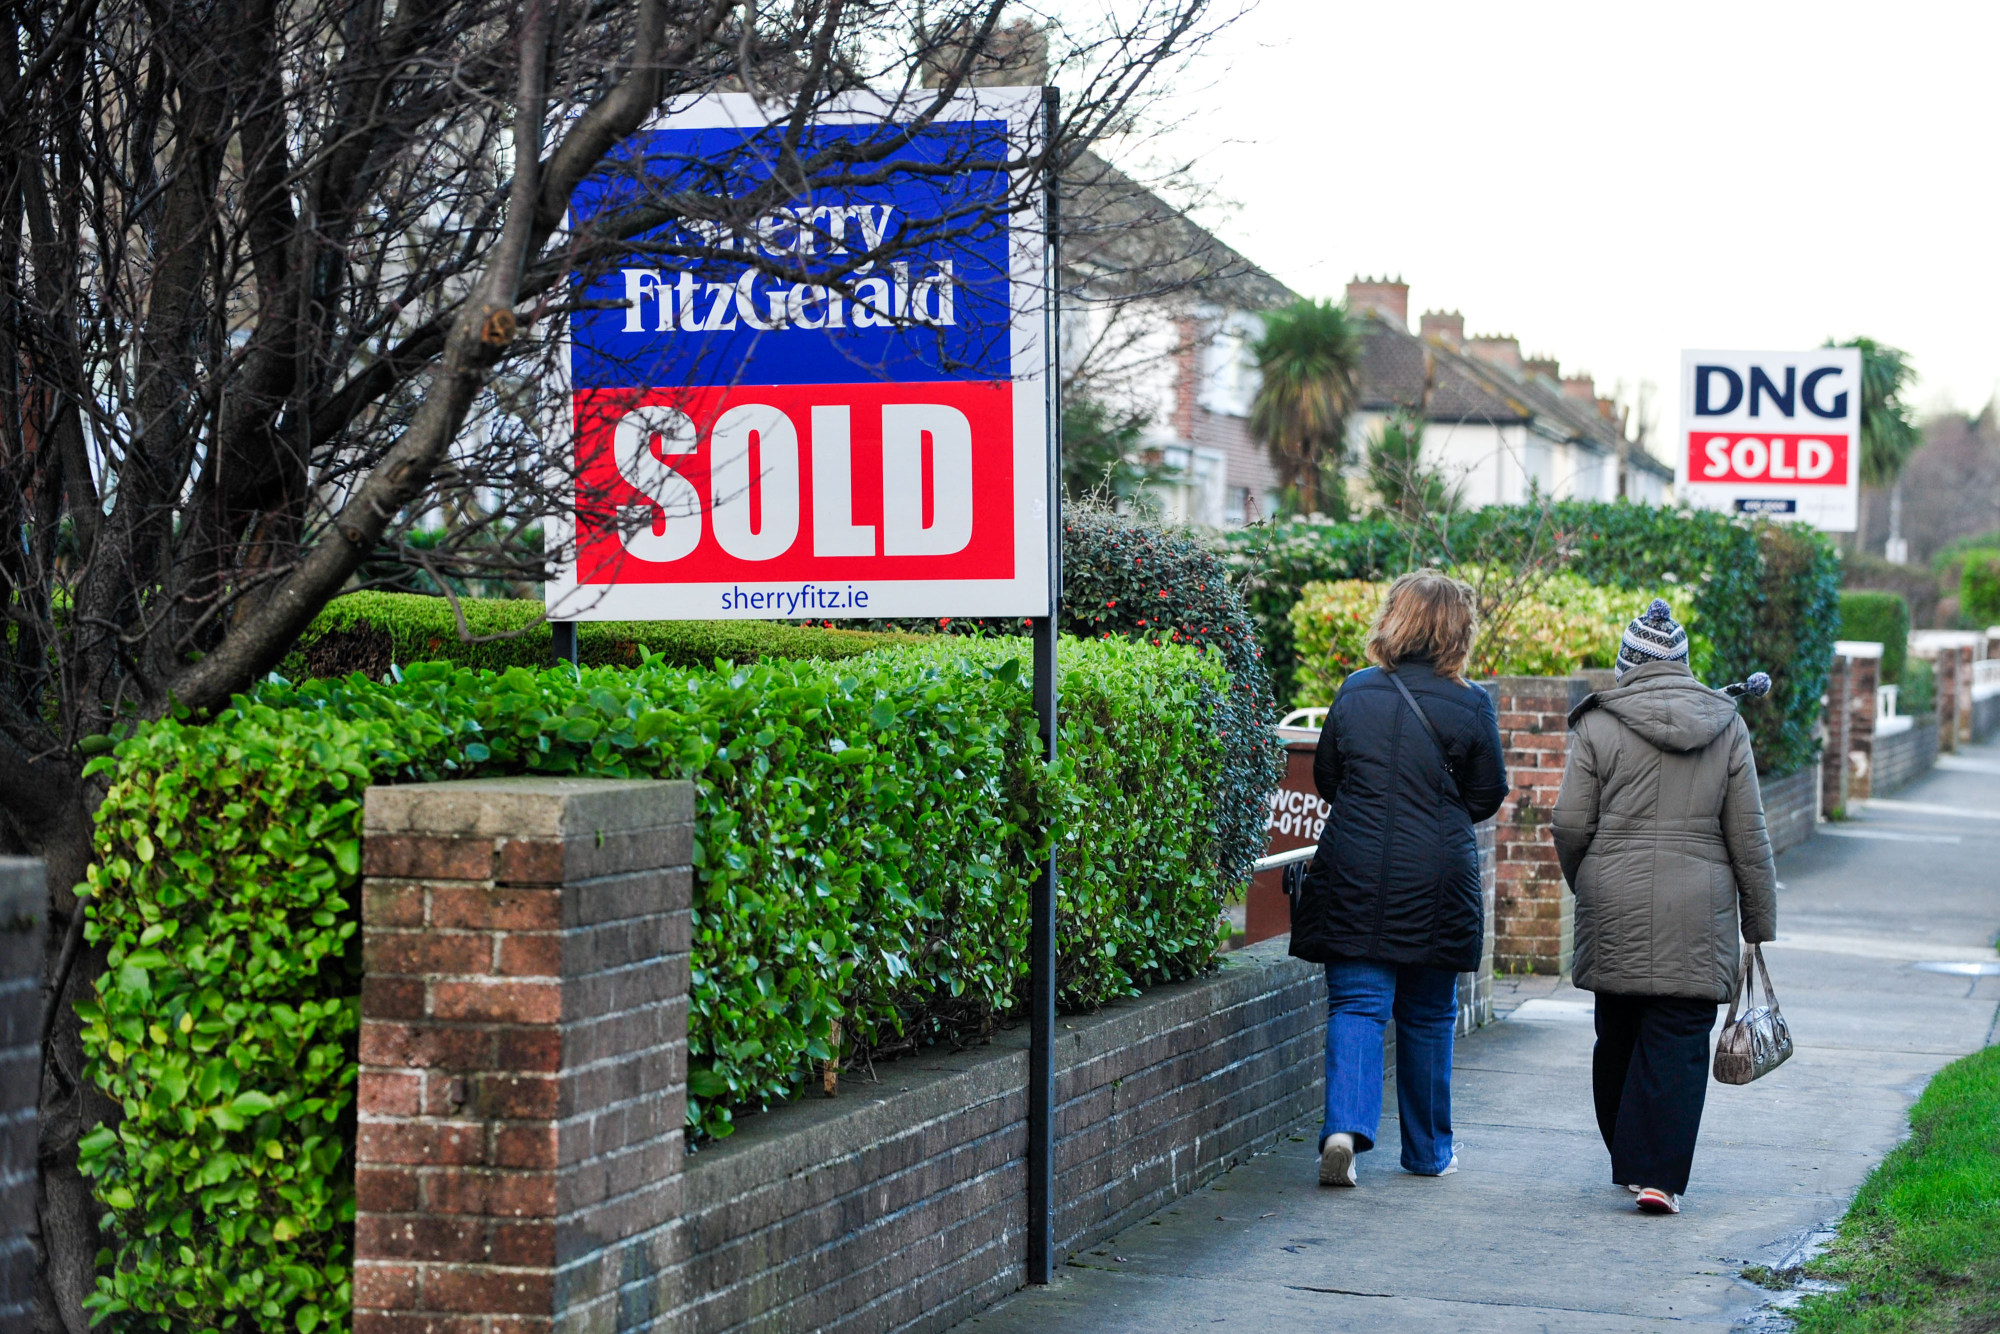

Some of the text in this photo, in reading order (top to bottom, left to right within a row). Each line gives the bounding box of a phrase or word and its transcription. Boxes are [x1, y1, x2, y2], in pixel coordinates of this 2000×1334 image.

[621, 260, 957, 332] FitzGerald
[1695, 365, 1848, 419] DNG
[614, 403, 973, 563] SOLD
[1703, 436, 1834, 479] SOLD
[721, 584, 869, 615] sherryfitz.ie
